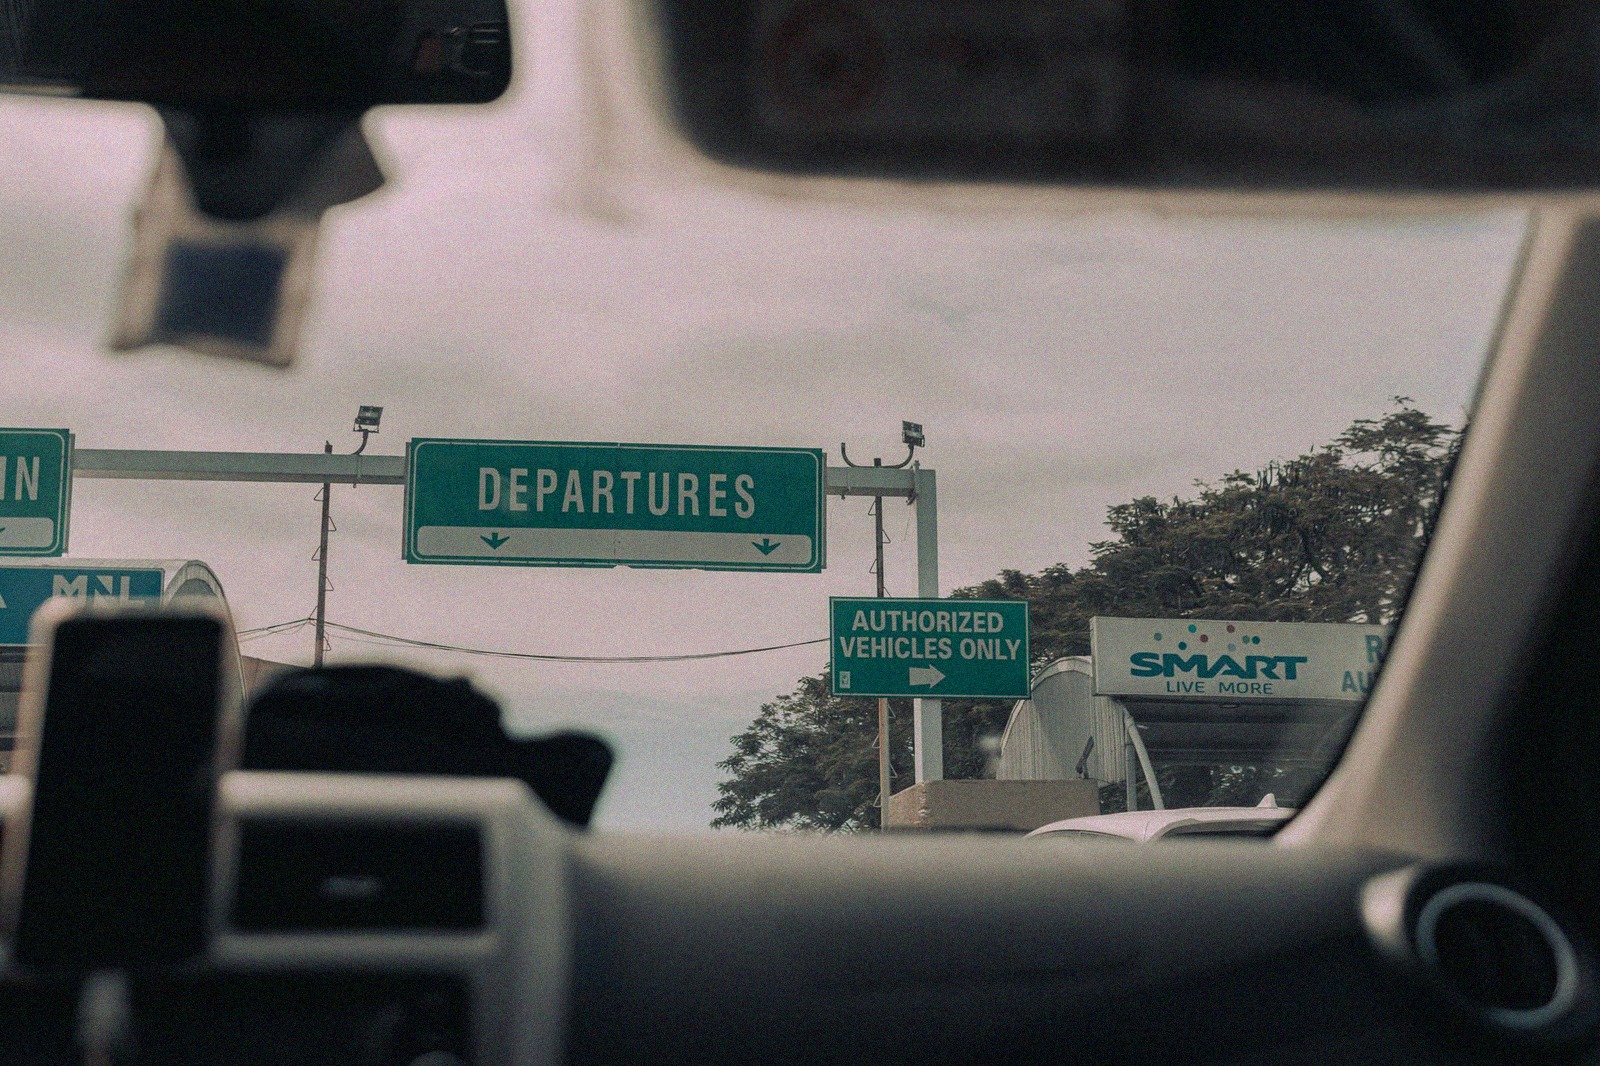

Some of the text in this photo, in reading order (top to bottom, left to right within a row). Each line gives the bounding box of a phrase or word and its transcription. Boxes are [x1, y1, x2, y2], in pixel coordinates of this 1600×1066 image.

[478, 466, 756, 519] DEPARTURES
[852, 610, 1004, 633] AUTHORIZED
[840, 636, 1021, 661] VEHICLES ONLY
[1130, 651, 1308, 681] SMART
[1166, 680, 1273, 695] LIVE MORE
